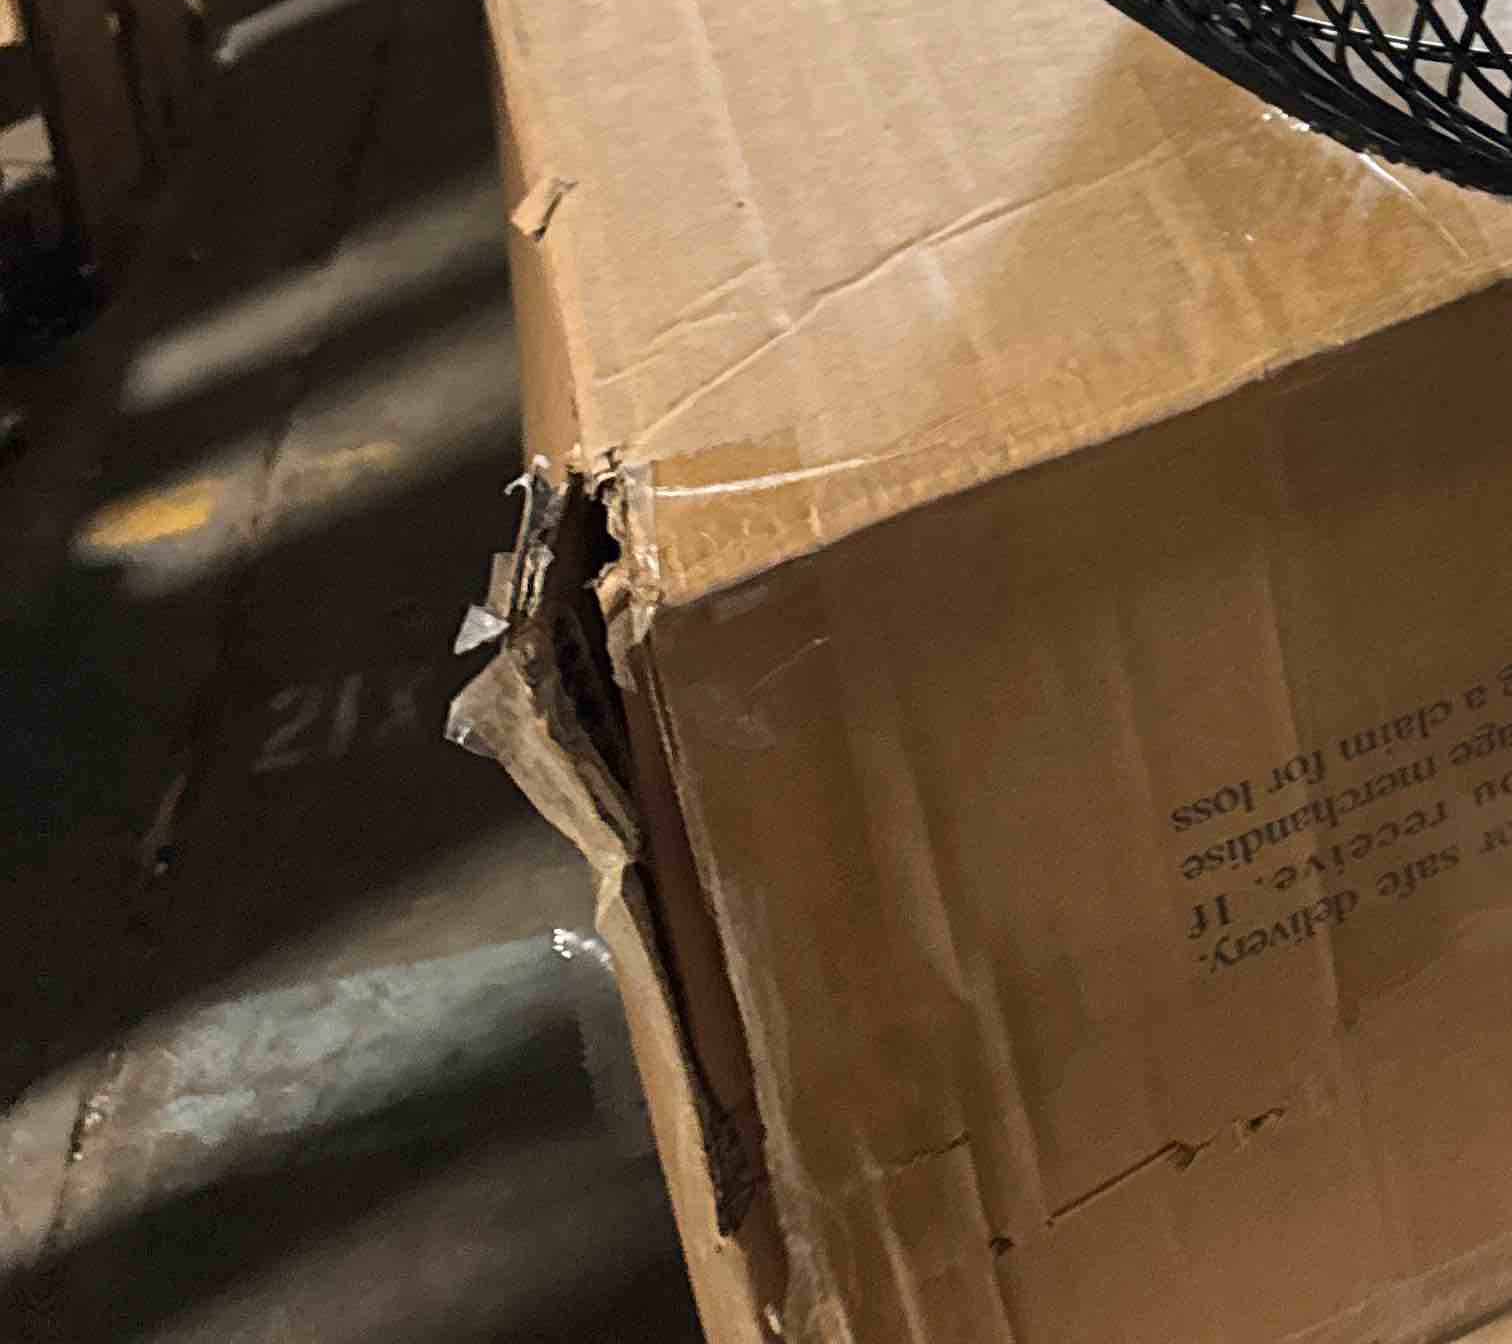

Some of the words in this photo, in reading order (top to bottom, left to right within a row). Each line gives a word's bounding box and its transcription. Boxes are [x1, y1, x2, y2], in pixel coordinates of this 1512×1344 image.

[1464, 685, 1486, 710] a
[1338, 699, 1453, 763] claim
[1266, 749, 1324, 794] for
[1170, 779, 1254, 833] loss
[1182, 756, 1437, 883] merchandise
[1256, 801, 1446, 891] receive.
[1375, 846, 1460, 901] safe
[1186, 895, 1229, 939] If
[1198, 889, 1358, 974] delivery.
